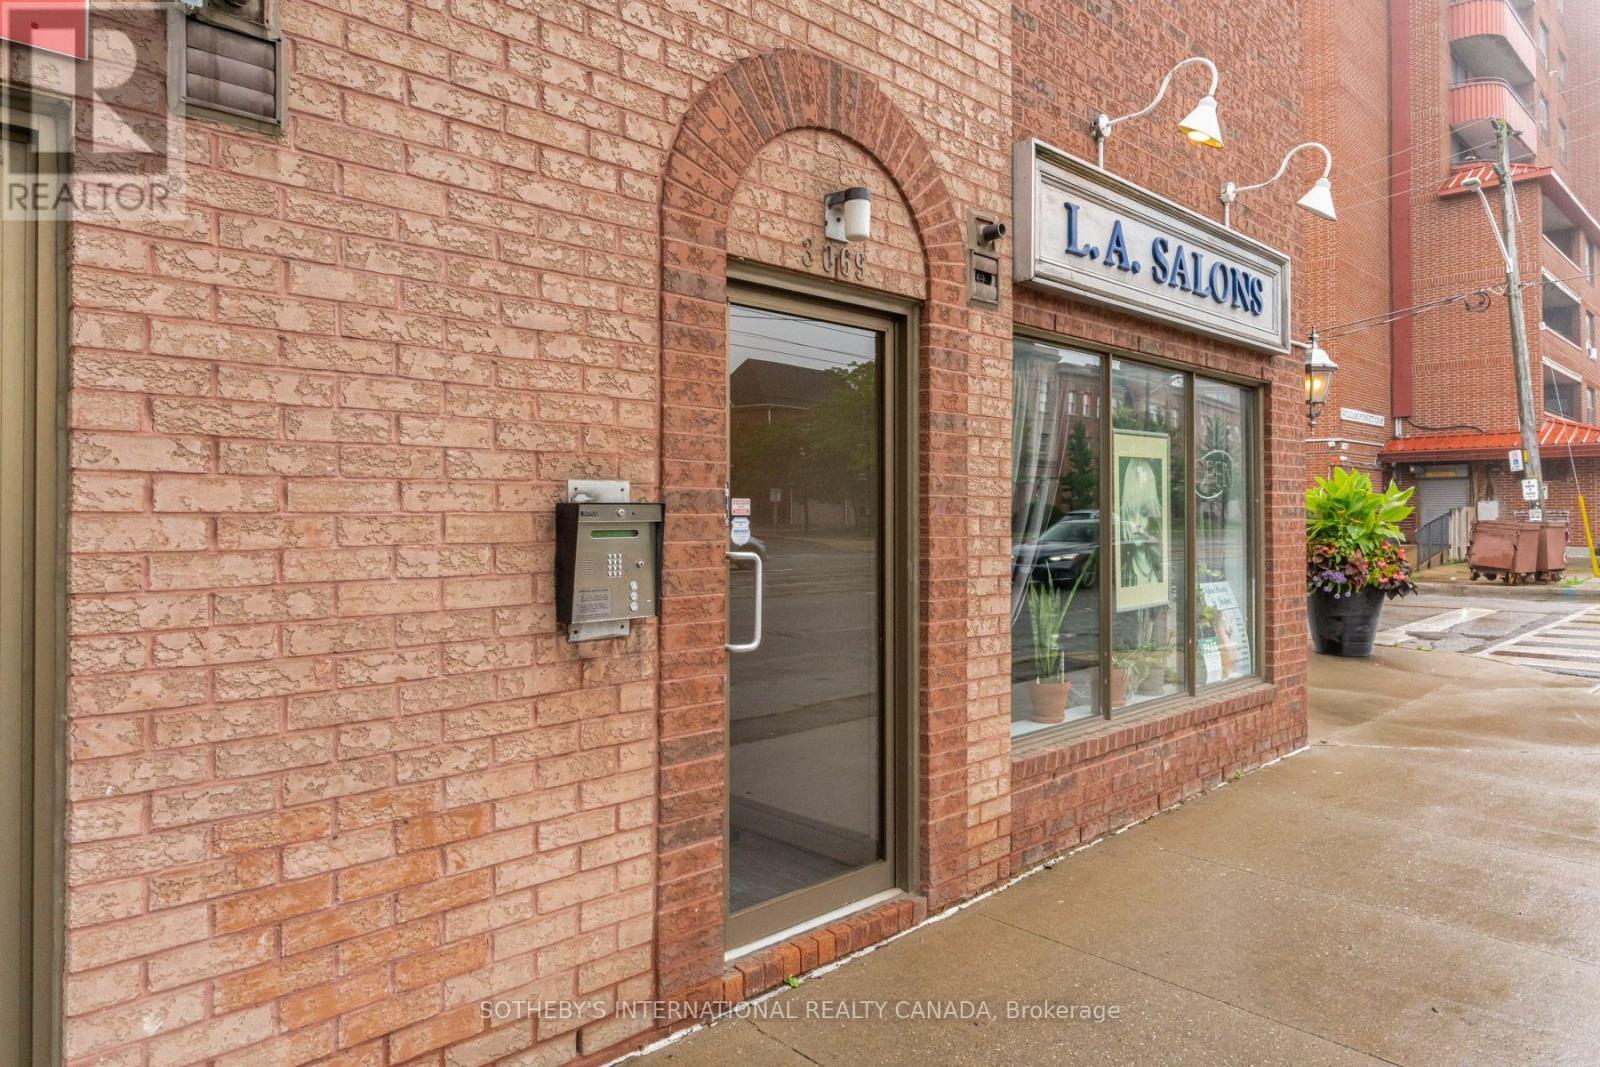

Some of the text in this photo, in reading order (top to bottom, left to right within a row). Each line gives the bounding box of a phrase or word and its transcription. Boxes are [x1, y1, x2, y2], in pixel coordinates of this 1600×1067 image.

[800, 237, 865, 281] 3069
[1063, 201, 1264, 317] L.A. SALONS
